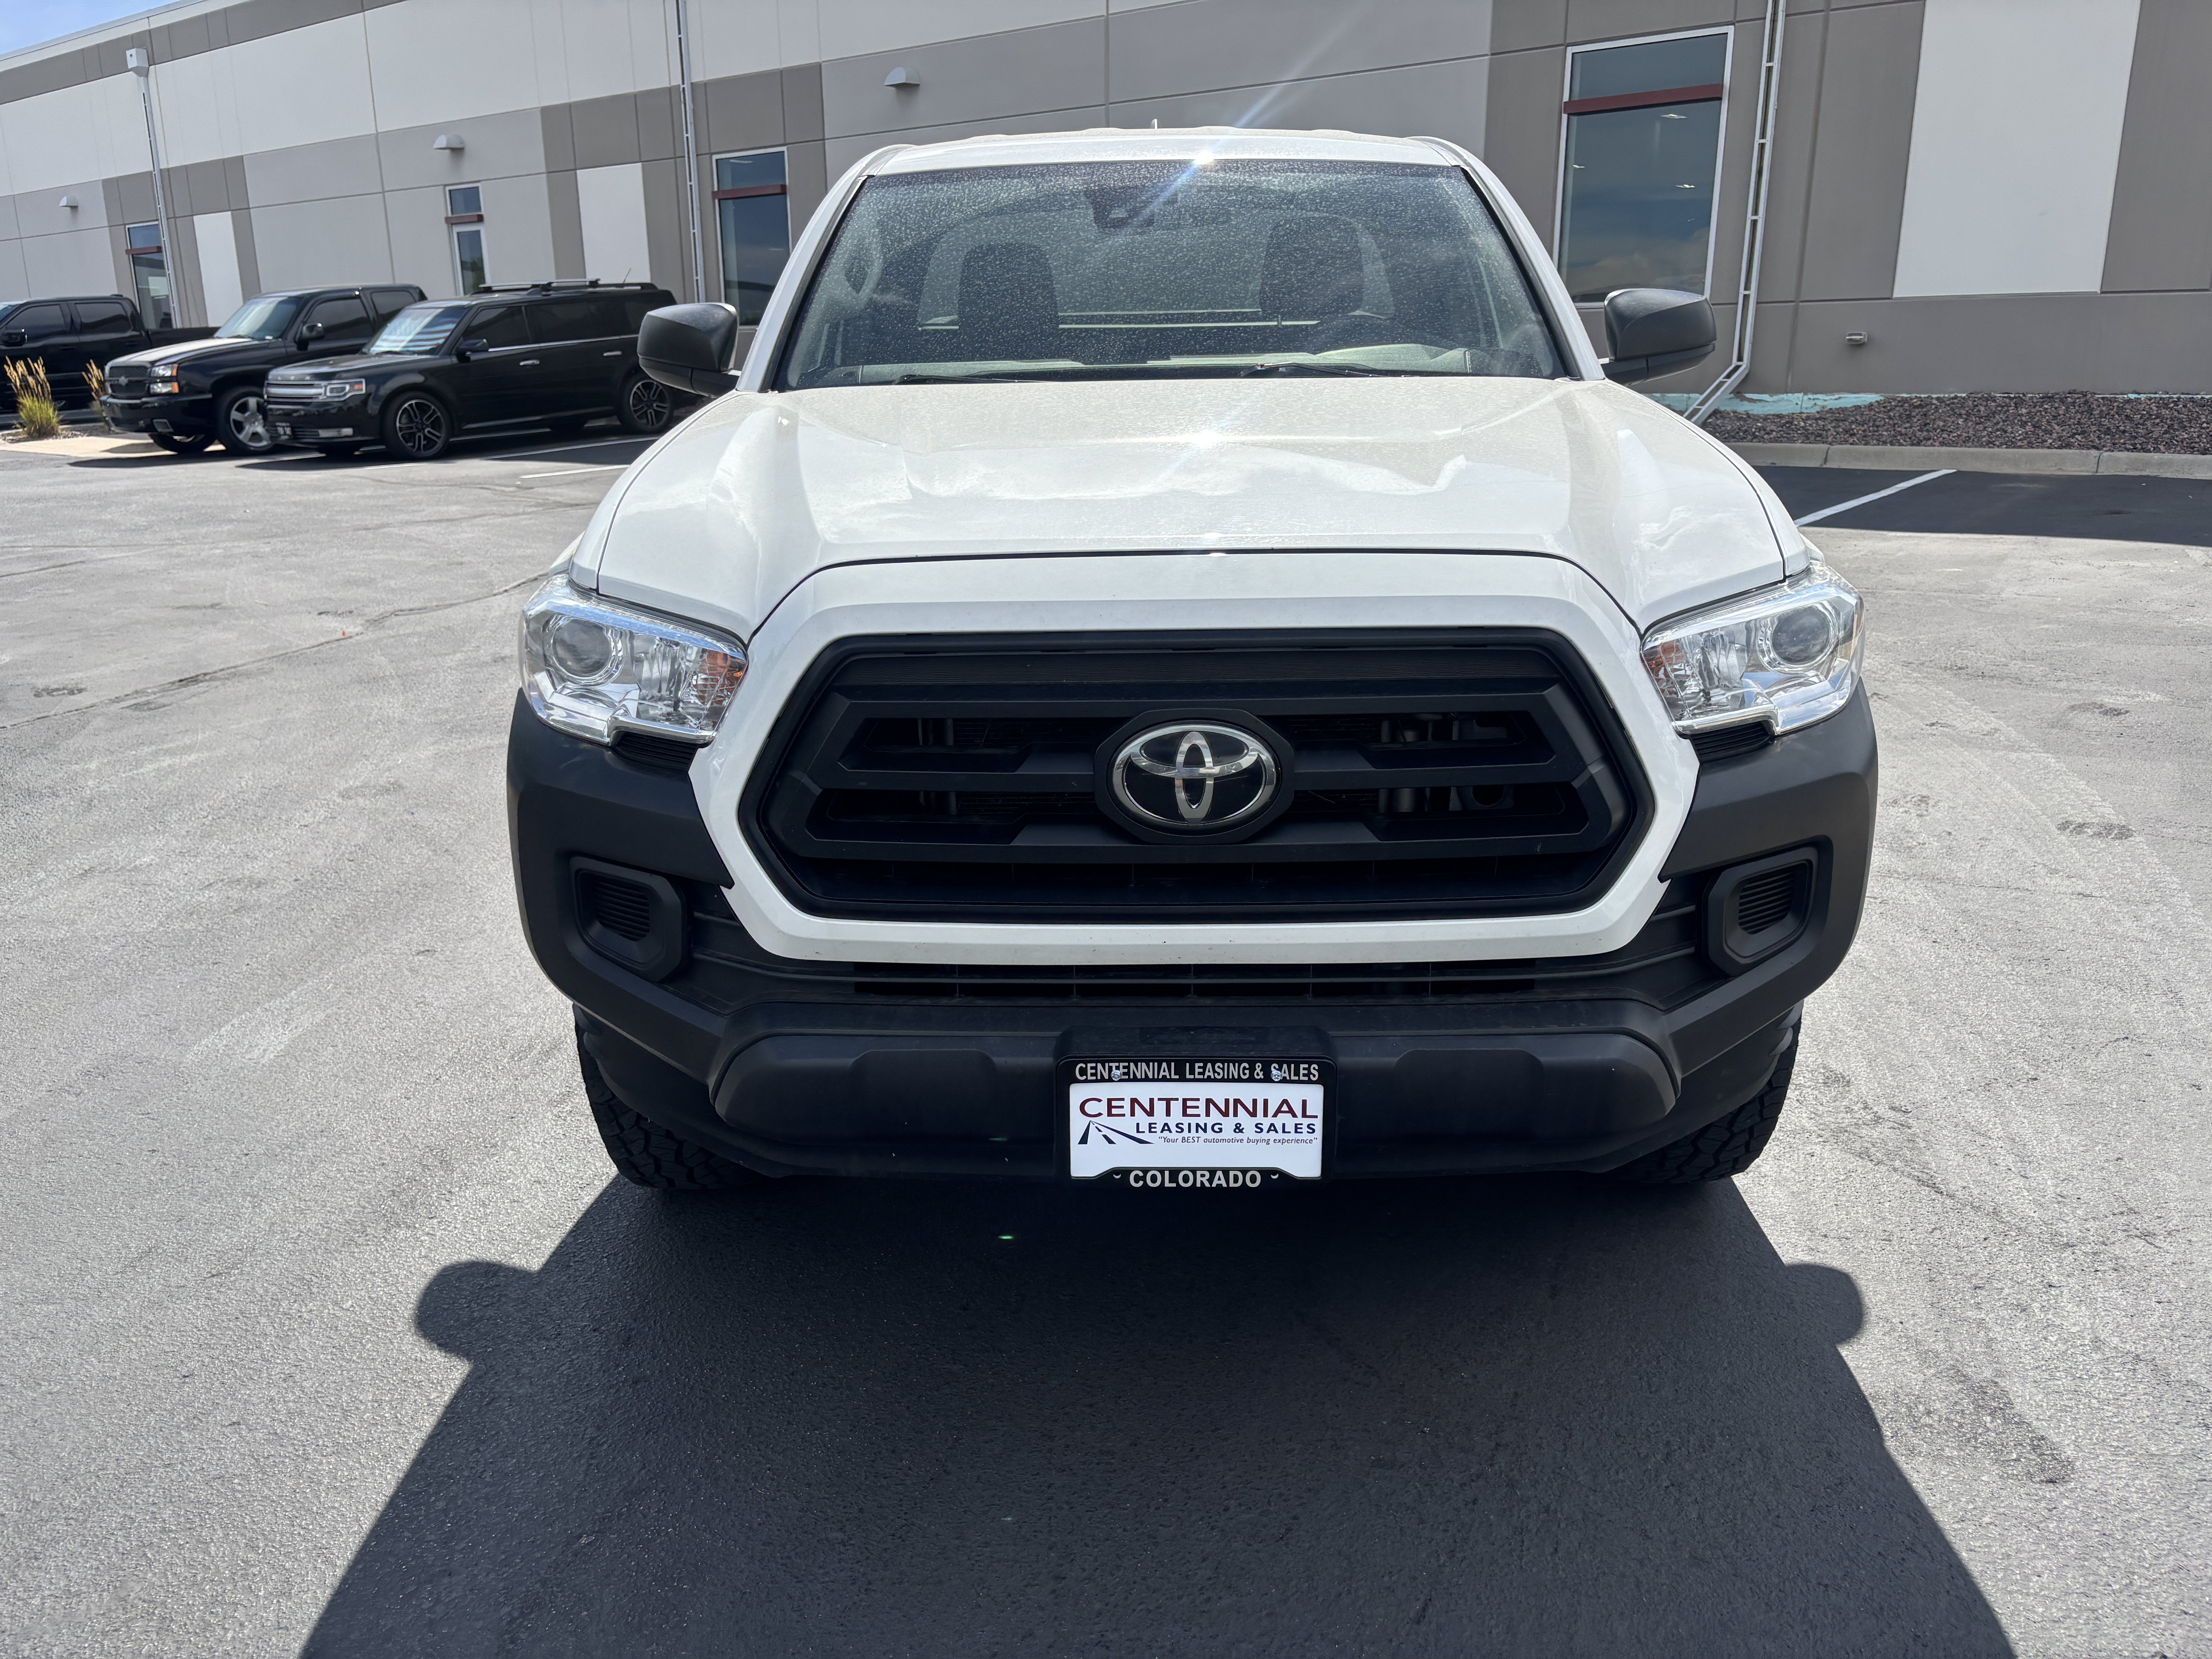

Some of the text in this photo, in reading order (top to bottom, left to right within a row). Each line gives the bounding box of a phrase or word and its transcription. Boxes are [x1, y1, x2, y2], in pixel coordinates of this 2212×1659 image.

[1075, 1062, 1179, 1080] CENTENNIAL
[1186, 1063, 1249, 1079] LEASING
[1254, 1063, 1264, 1079] &
[1079, 1097, 1318, 1118] CENTENNIAL
[1136, 1122, 1316, 1134] LEASING & SALES
[1247, 1137, 1271, 1145] buying
[1130, 1170, 1261, 1187] COLORADO
